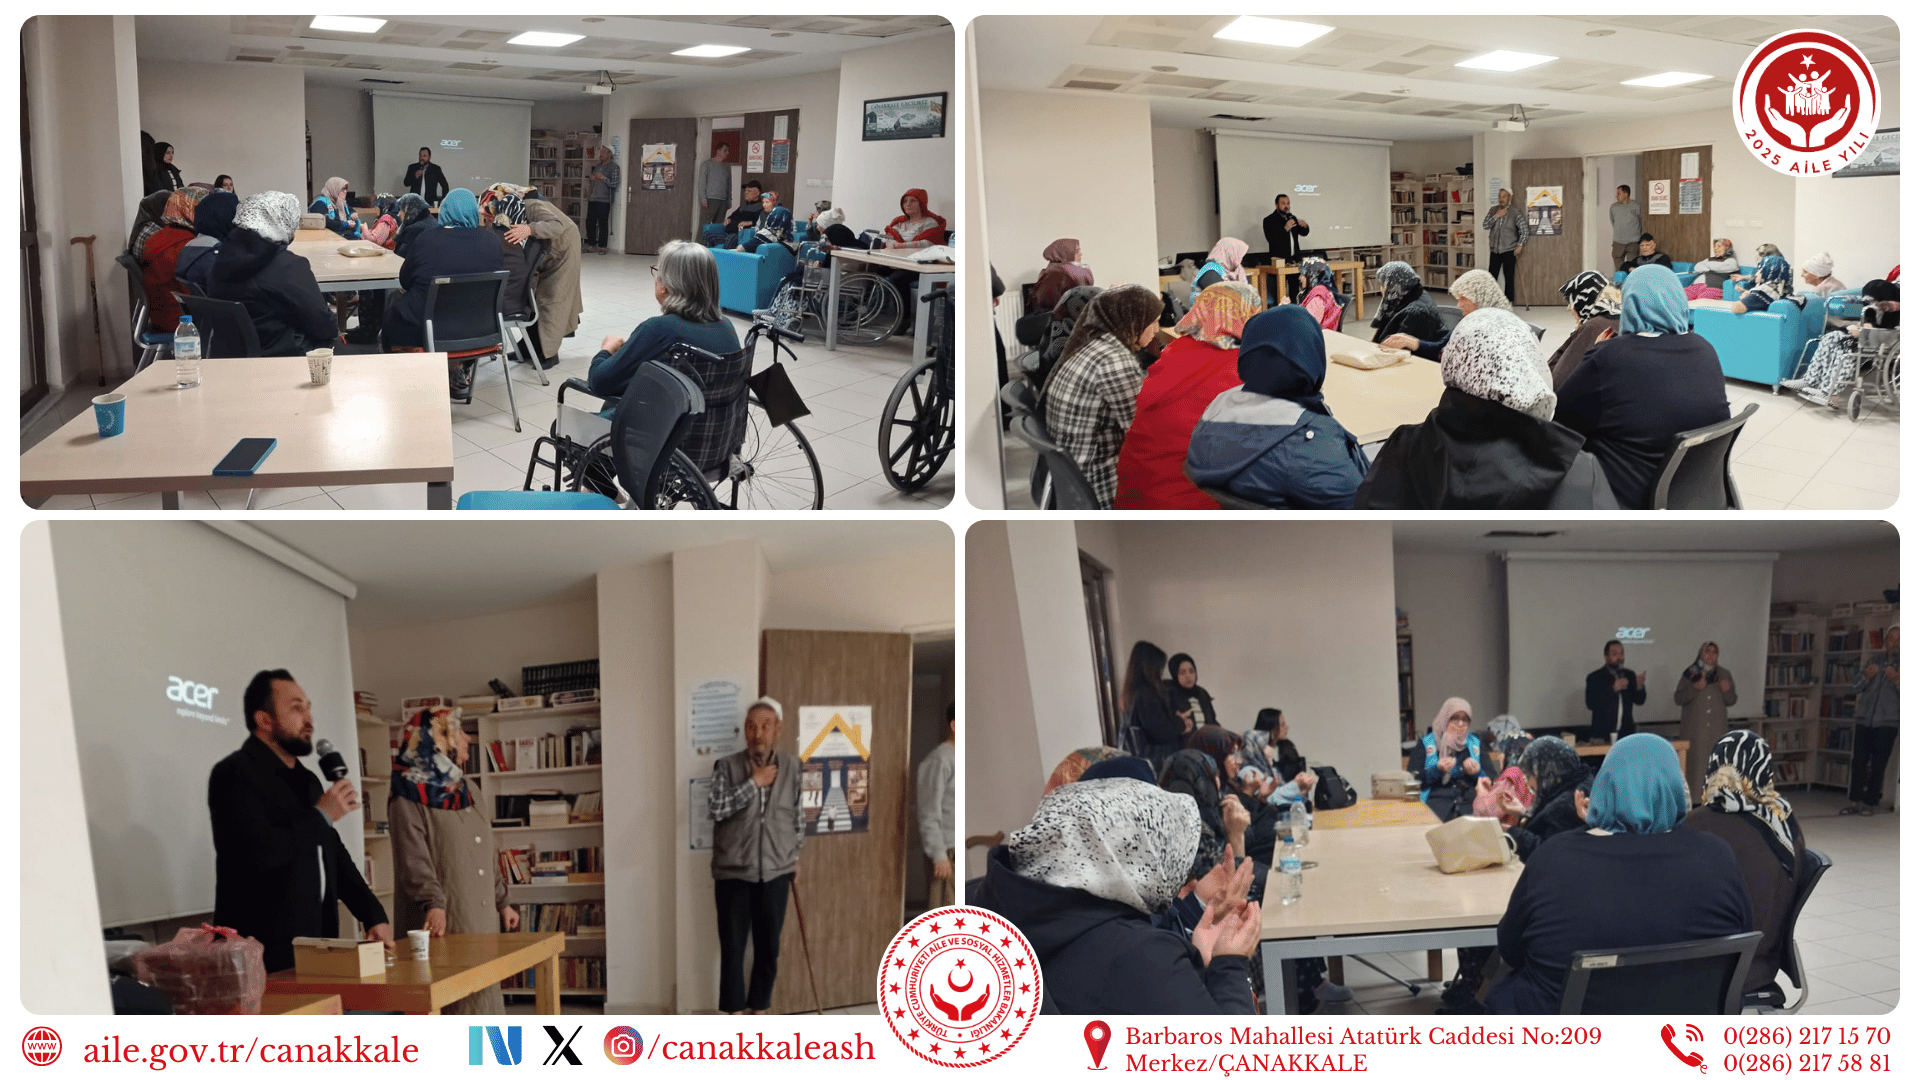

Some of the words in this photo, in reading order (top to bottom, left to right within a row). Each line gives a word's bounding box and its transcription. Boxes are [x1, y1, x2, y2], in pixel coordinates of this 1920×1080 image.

[441, 139, 461, 147] acer
[1615, 627, 1651, 639] acer
[166, 675, 219, 710] acer
